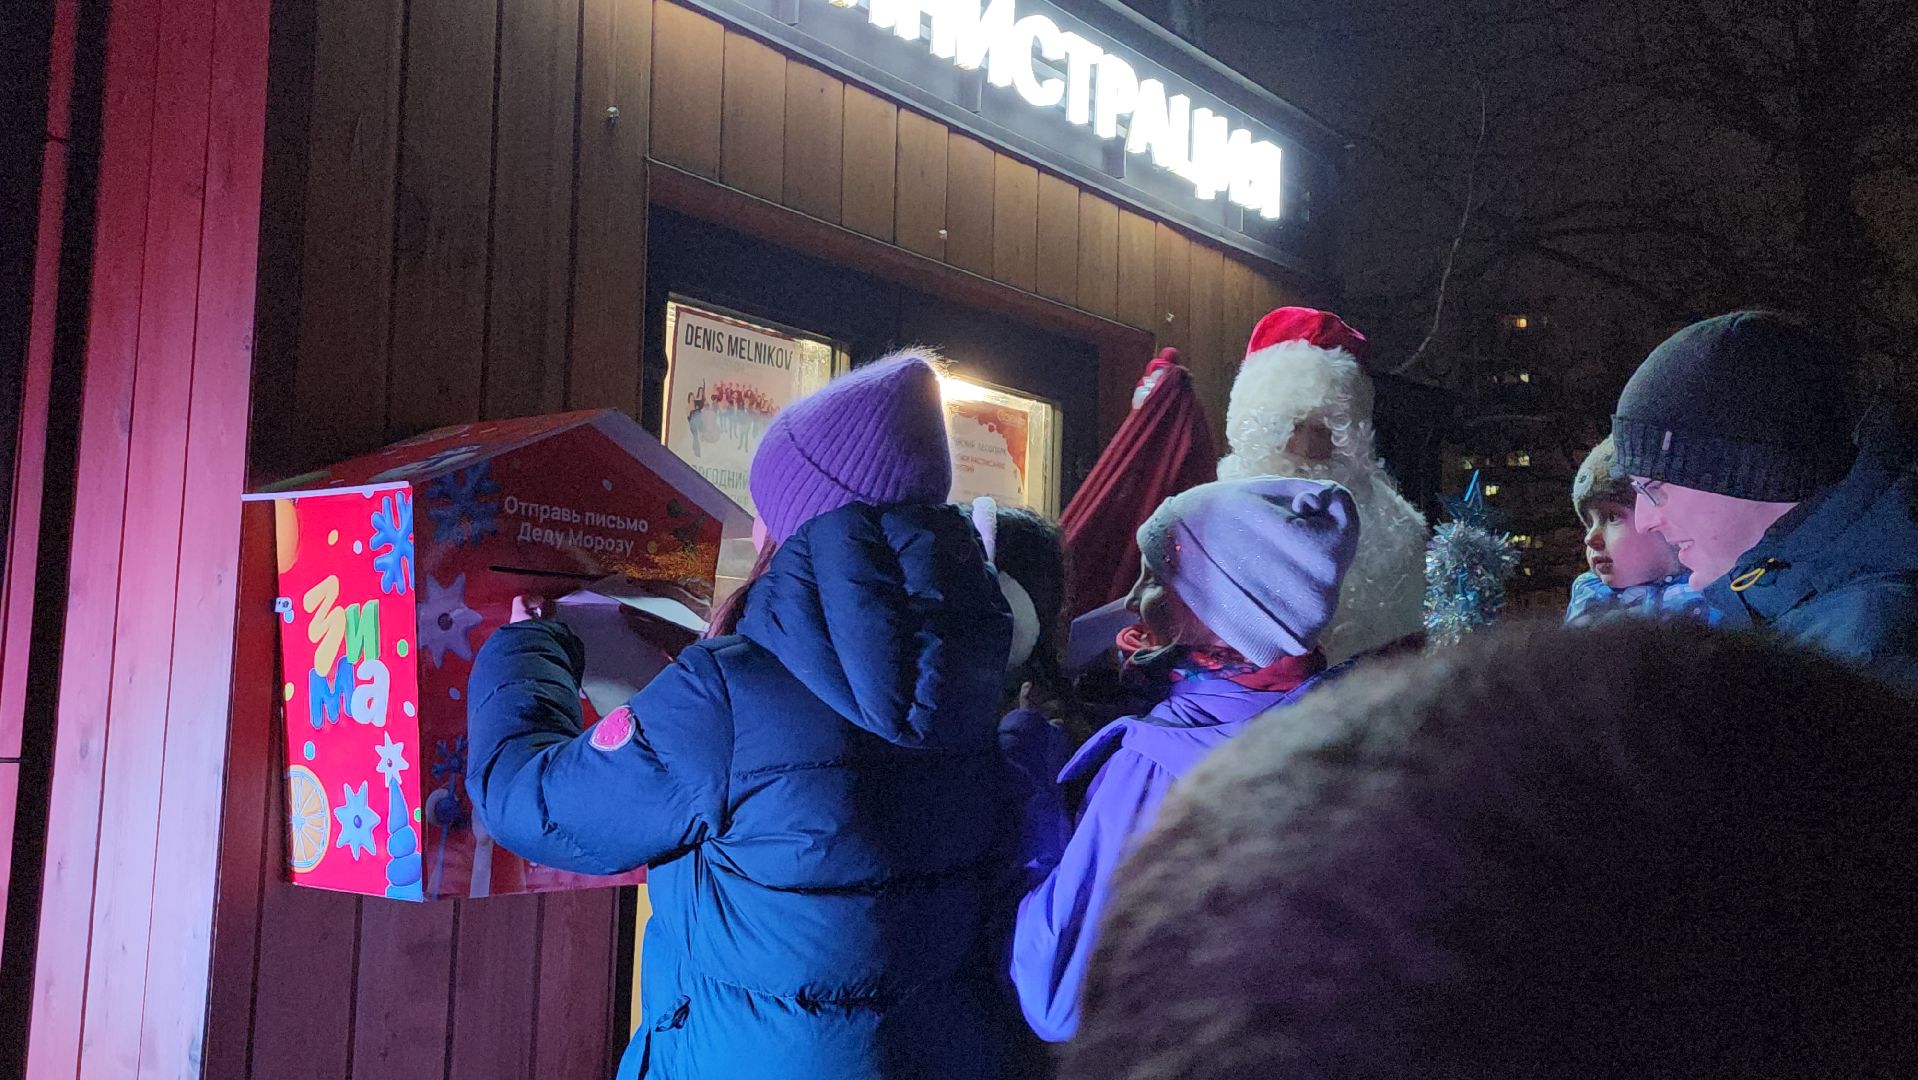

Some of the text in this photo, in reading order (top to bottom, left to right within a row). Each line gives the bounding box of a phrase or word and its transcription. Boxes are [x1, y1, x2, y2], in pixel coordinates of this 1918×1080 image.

[685, 323, 793, 371] DENIS MELNIKOV
[504, 496, 649, 533] Отправь письмо
[517, 522, 634, 557] Деду Морозу
